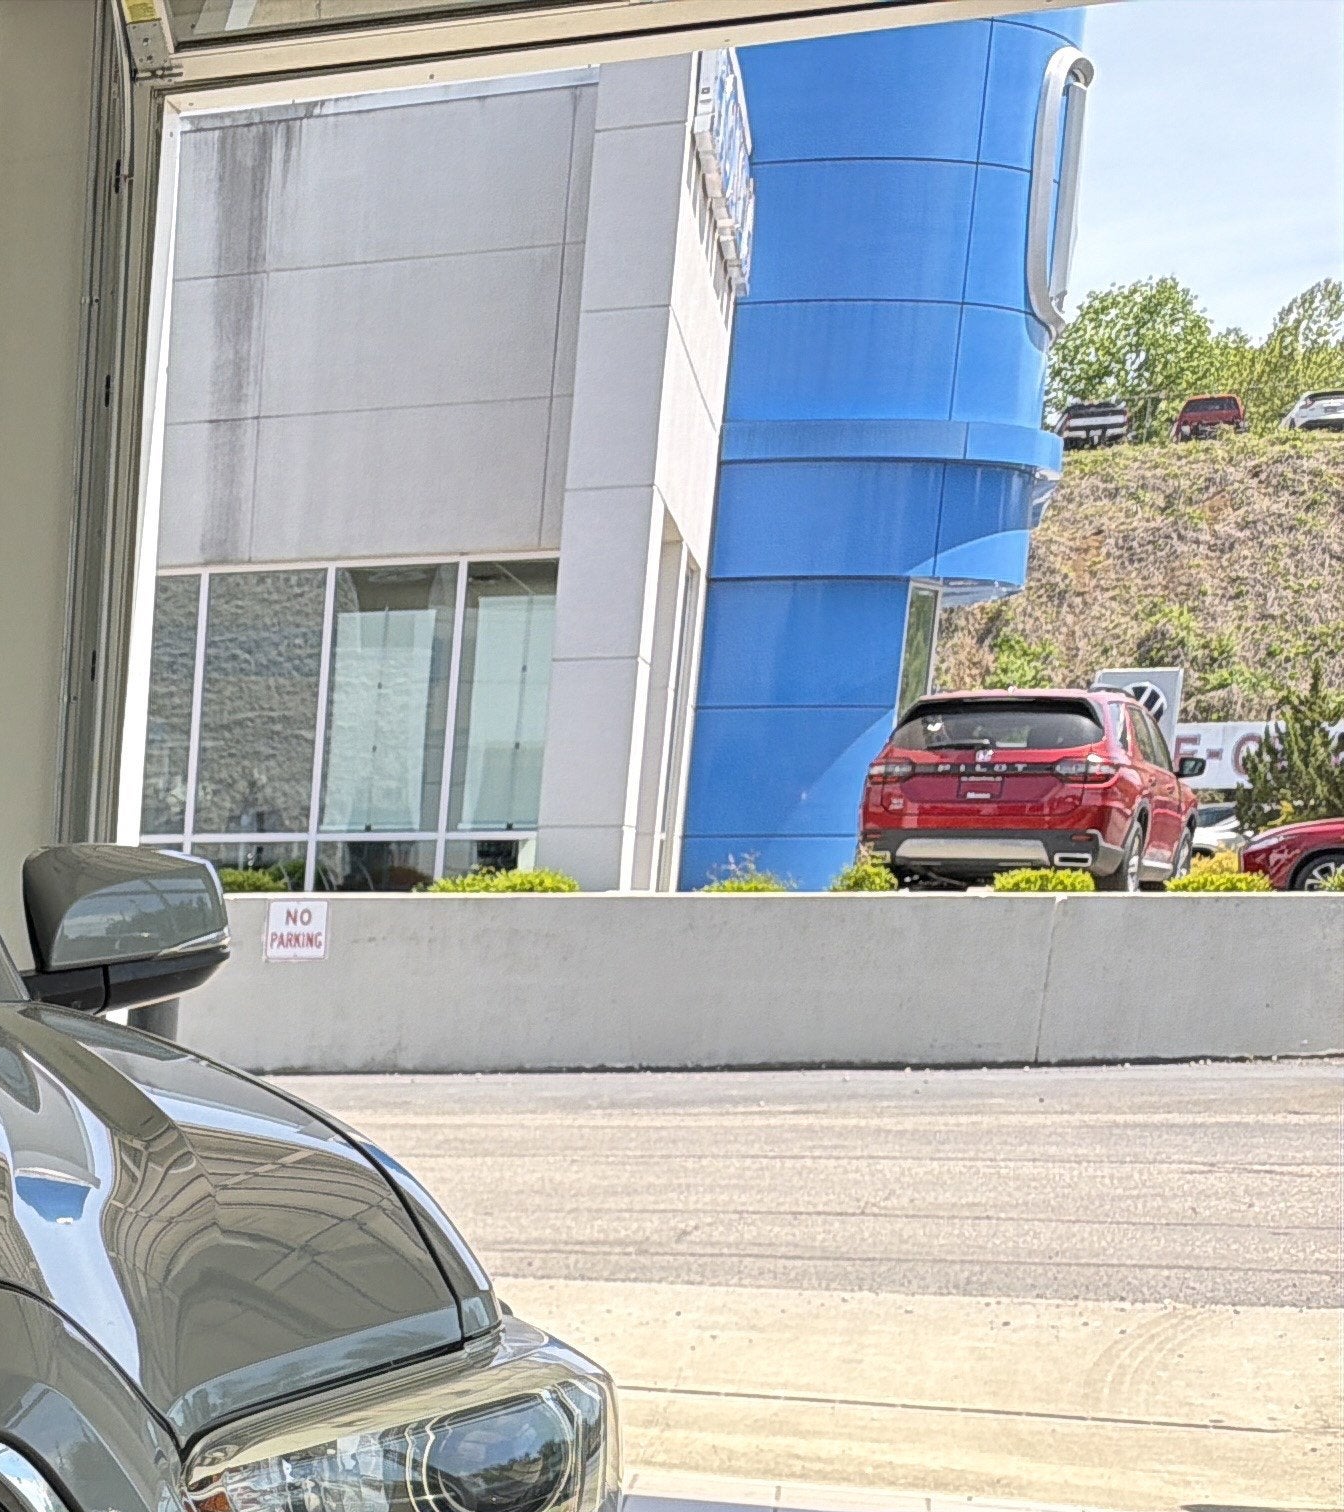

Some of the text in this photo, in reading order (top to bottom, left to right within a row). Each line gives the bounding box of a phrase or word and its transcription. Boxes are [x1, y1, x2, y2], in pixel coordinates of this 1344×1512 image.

[937, 763, 1028, 773] PILOT
[285, 907, 313, 926] NO
[270, 931, 323, 949] PARKING
